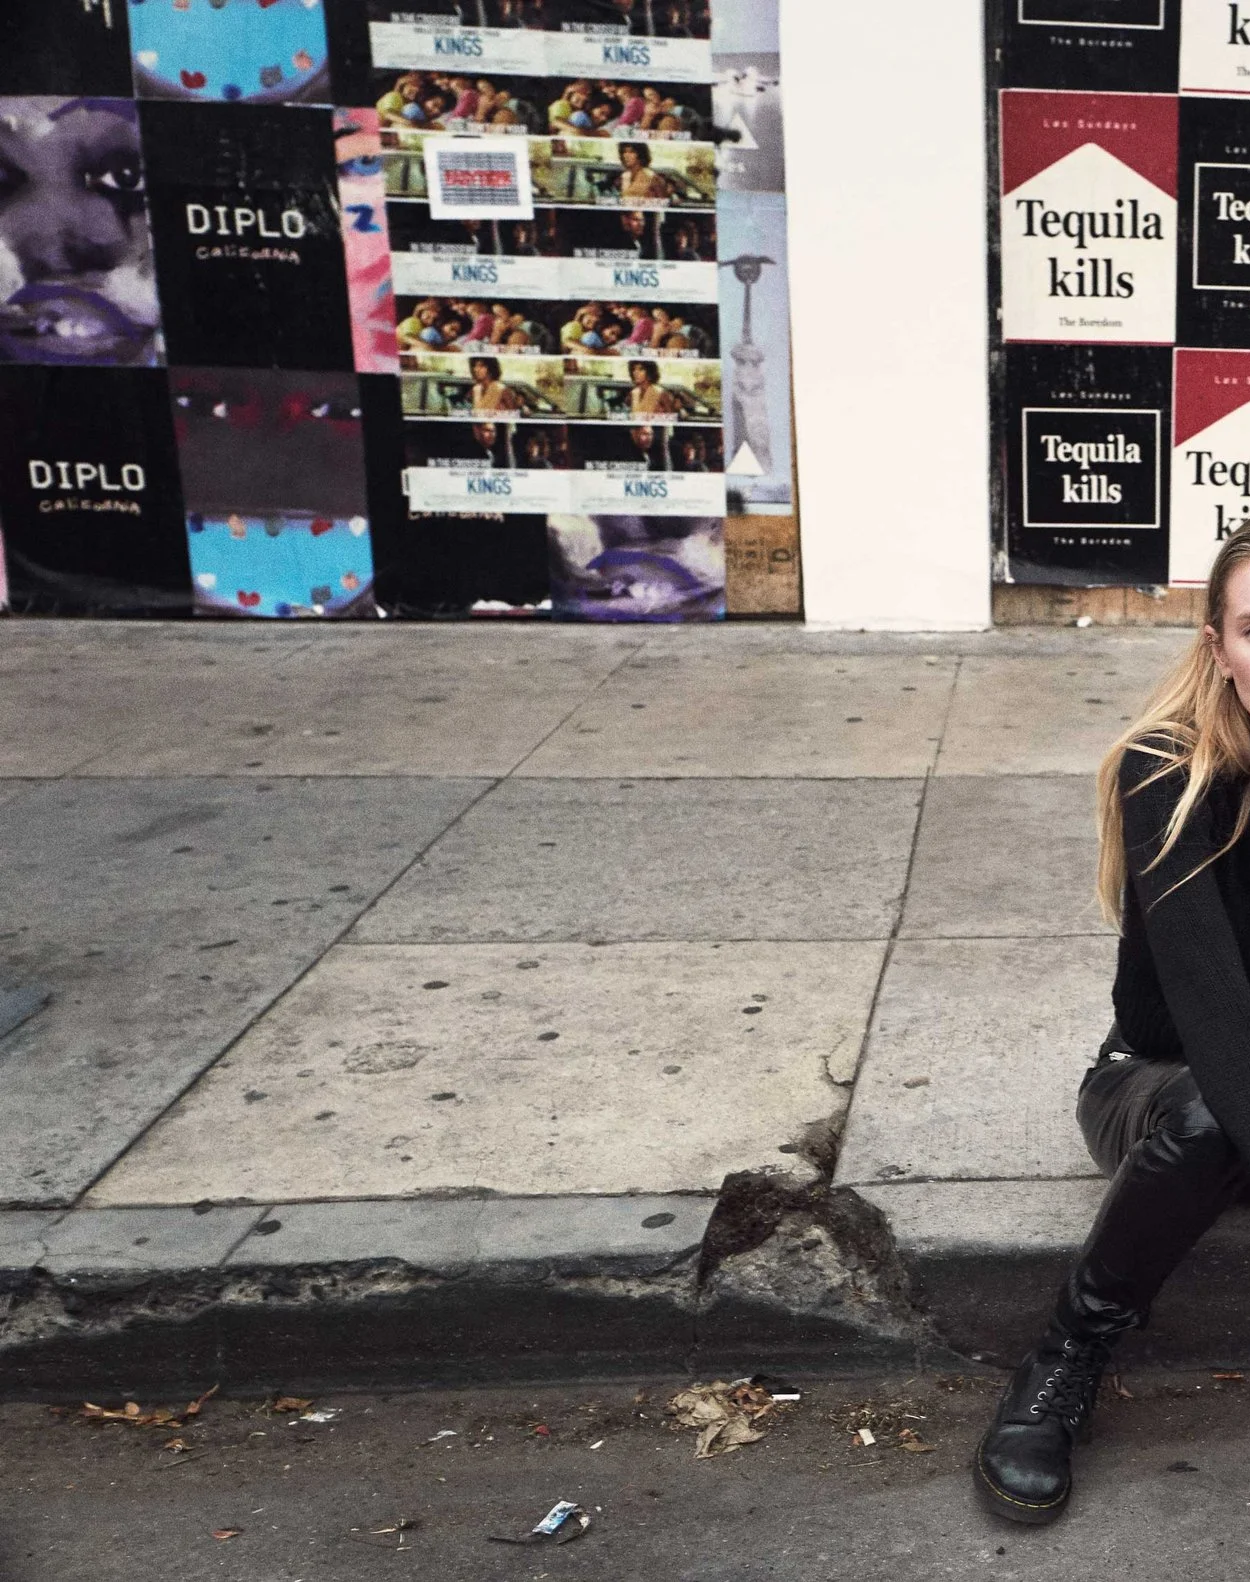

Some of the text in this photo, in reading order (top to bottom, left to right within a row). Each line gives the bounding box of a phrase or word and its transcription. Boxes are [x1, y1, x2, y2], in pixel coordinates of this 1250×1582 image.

[434, 36, 483, 56] KINGS
[1050, 35, 1072, 46] The
[603, 45, 650, 65] KINGS
[186, 203, 306, 239] DIPLO
[1016, 199, 1164, 248] Tequila
[452, 263, 498, 283] KINGS
[613, 269, 659, 288] KINGS
[1047, 257, 1134, 299] kills
[1221, 299, 1246, 310] The
[1057, 315, 1077, 328] The
[1041, 434, 1142, 469] Tequila
[28, 459, 146, 491] DIPLO
[467, 478, 512, 495] KINGS
[624, 480, 668, 498] KINGS
[1062, 475, 1123, 504] kills
[1052, 535, 1076, 546] The
